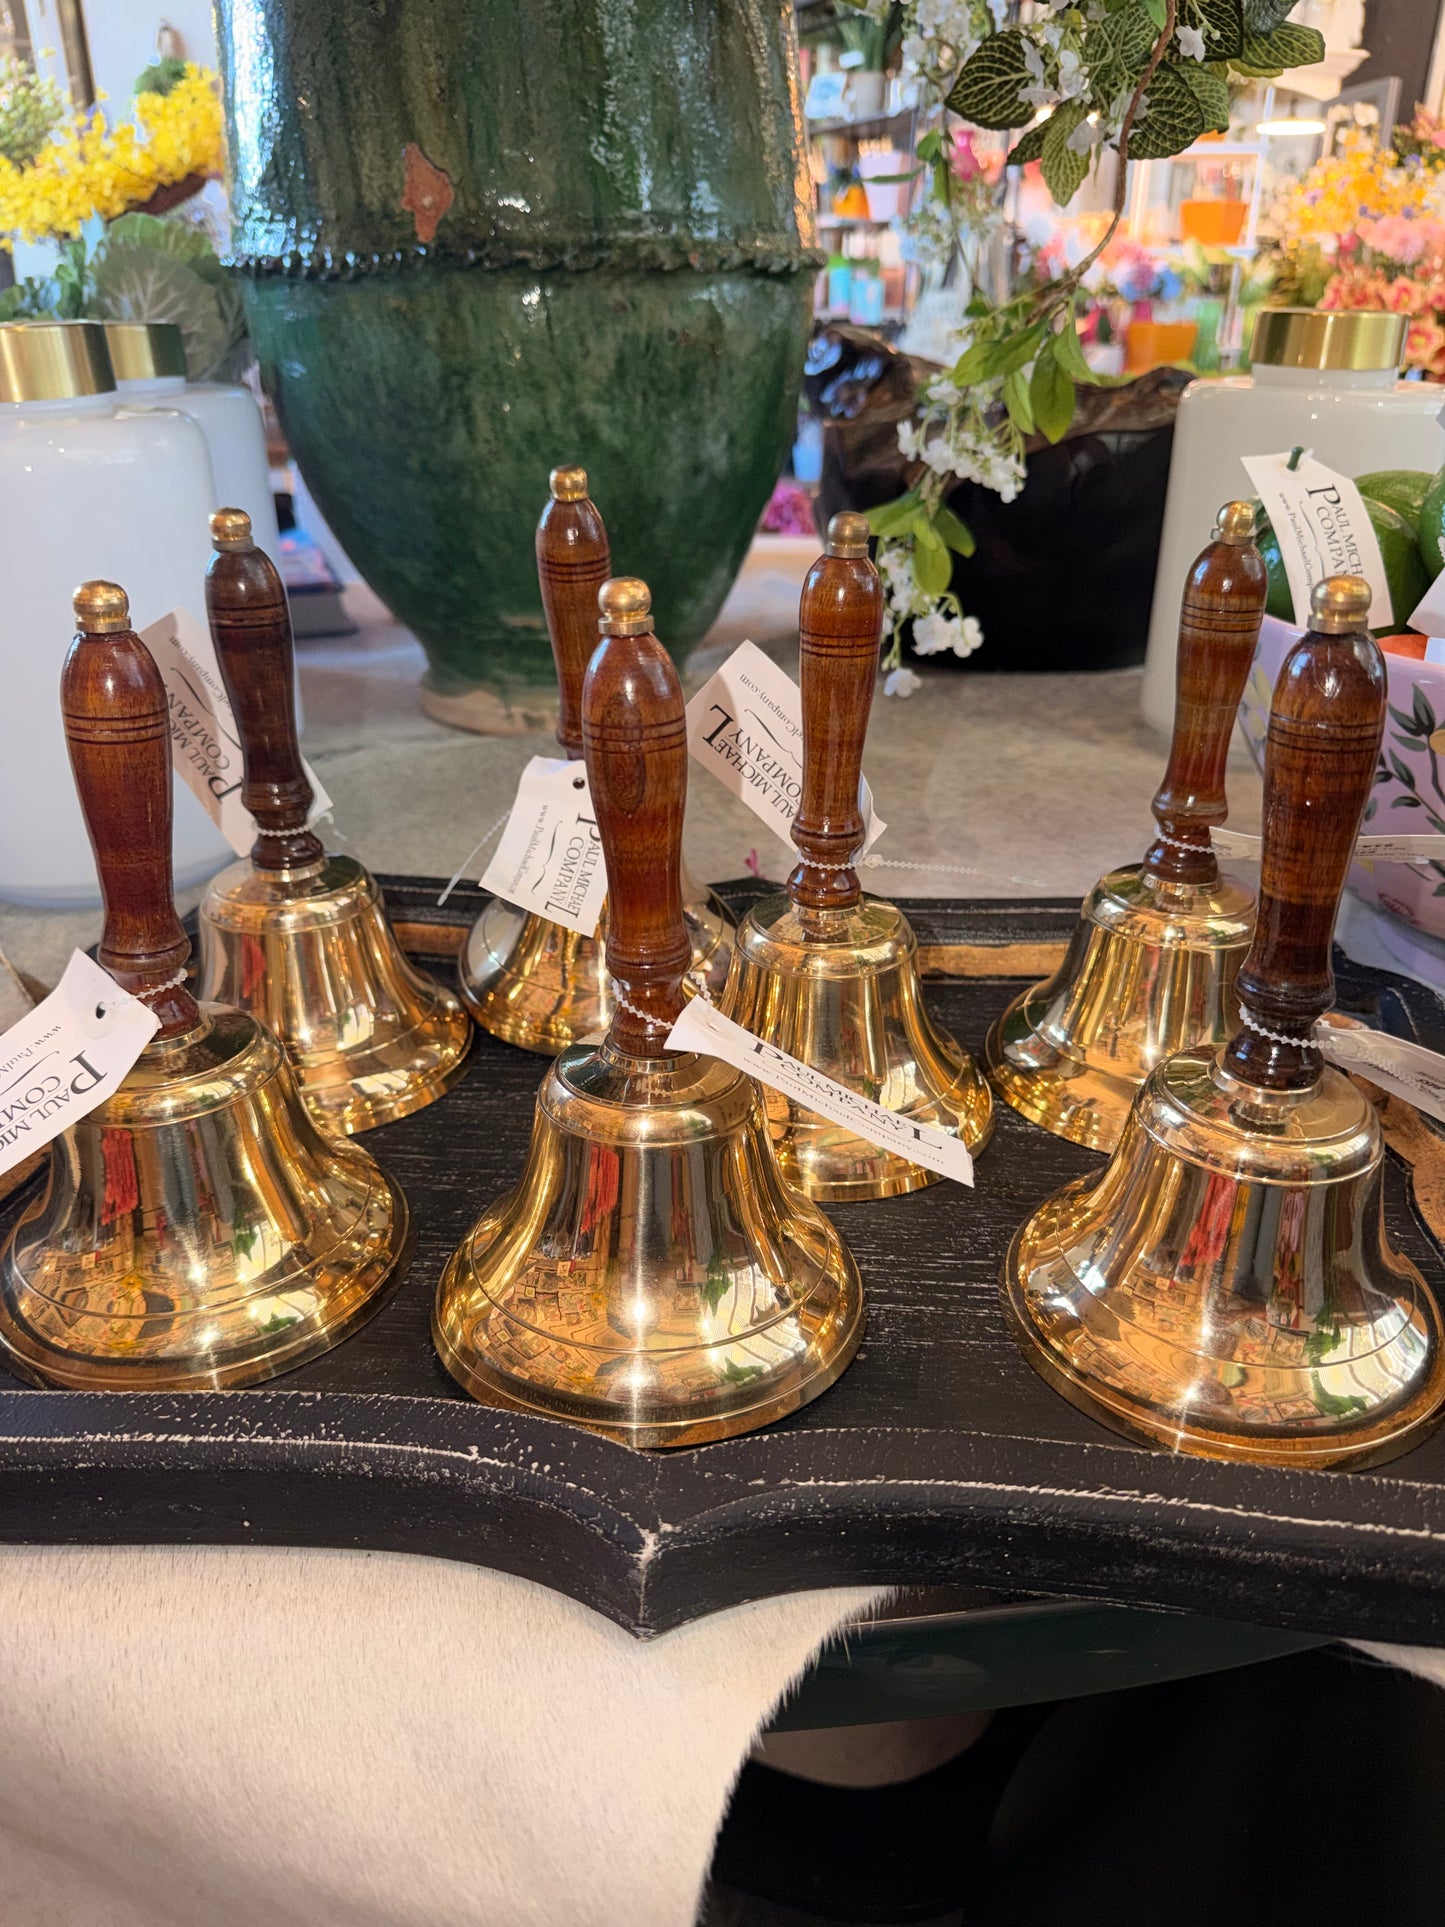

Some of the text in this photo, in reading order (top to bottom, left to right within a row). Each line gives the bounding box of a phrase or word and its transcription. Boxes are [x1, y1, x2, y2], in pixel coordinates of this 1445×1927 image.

[1305, 483, 1350, 533] PAUL
[164, 683, 231, 771] COMPAN
[190, 751, 244, 805] PAUL
[702, 704, 797, 820] AUL MICHAEL
[544, 812, 602, 919] PAUL MICHAEL
[549, 836, 585, 905] COMPANY
[0, 1076, 61, 1130] COM
[29, 1050, 108, 1120] PAUL
[749, 1038, 943, 1150] PAUL MICHAEL
[780, 1063, 906, 1131] COMPANY
